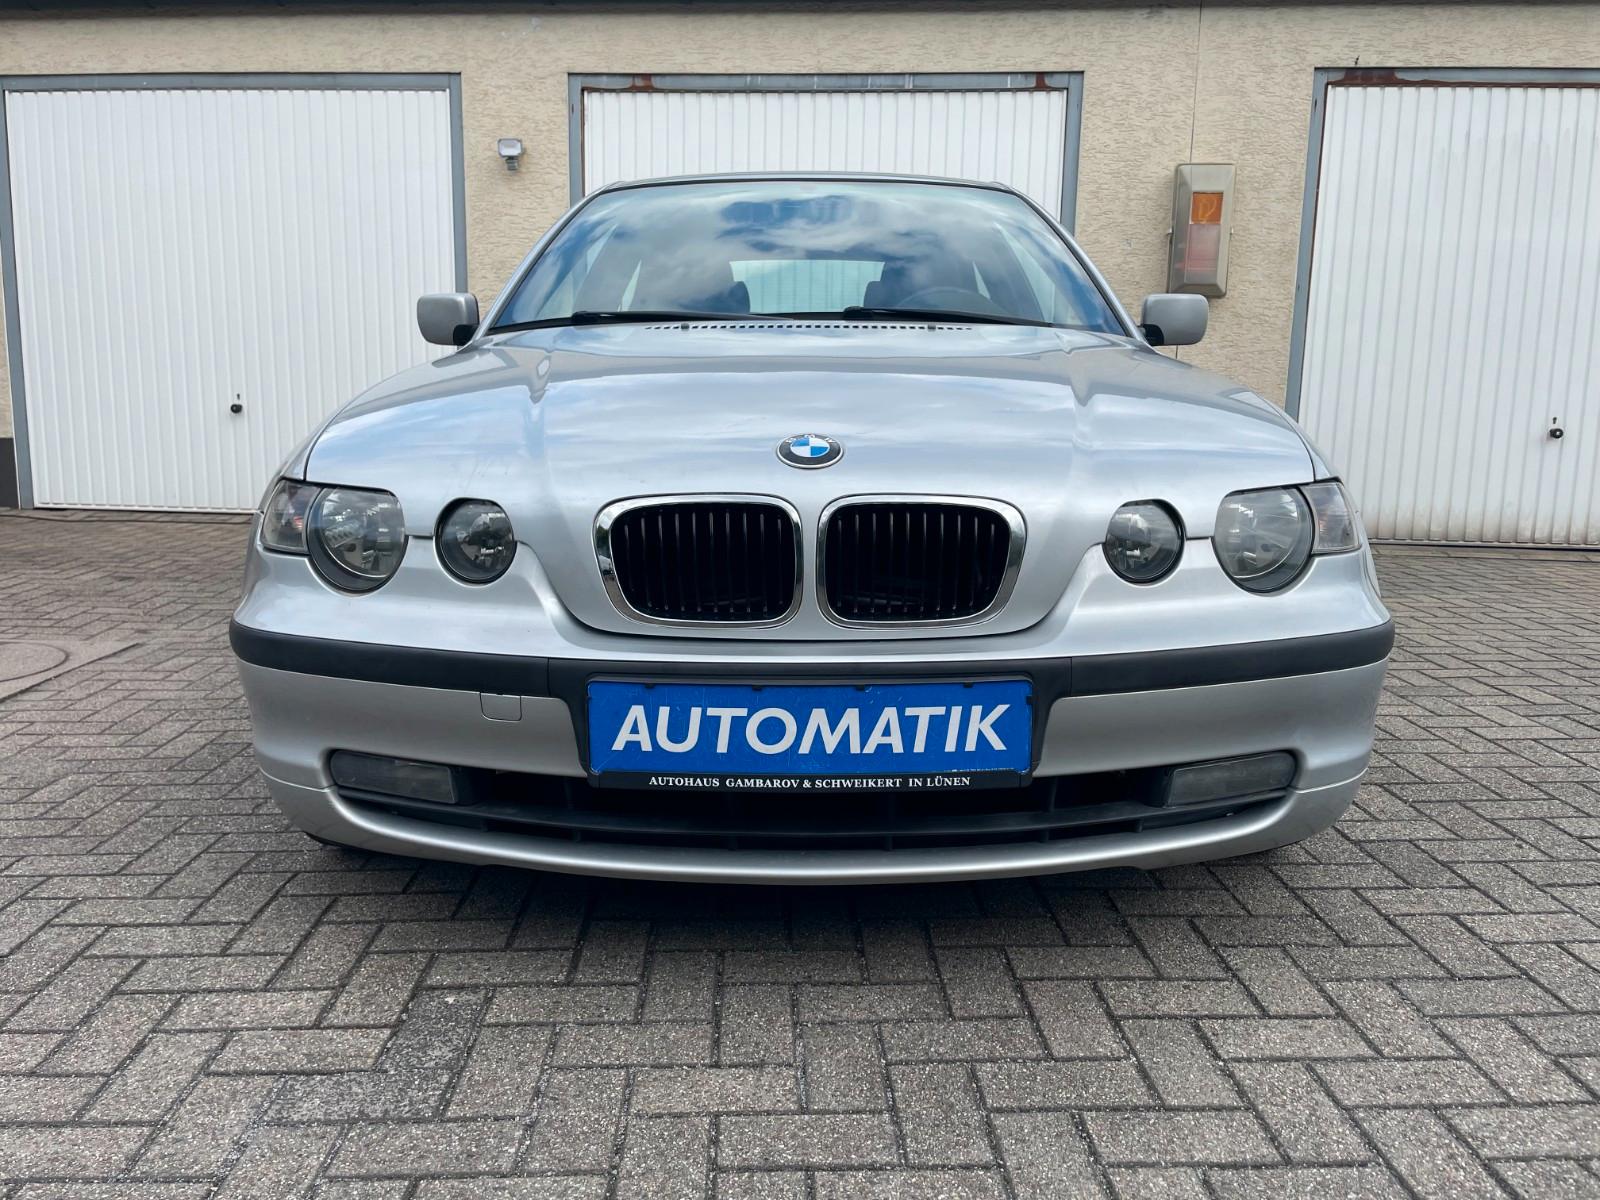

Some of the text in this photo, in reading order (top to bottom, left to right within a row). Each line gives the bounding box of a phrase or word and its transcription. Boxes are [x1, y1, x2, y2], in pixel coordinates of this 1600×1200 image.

[611, 704, 1010, 755] AUTOMATIK
[648, 775, 971, 789] AUTOHAUS GAMBAROV & SCHWEIKERT IN LÜNEN
